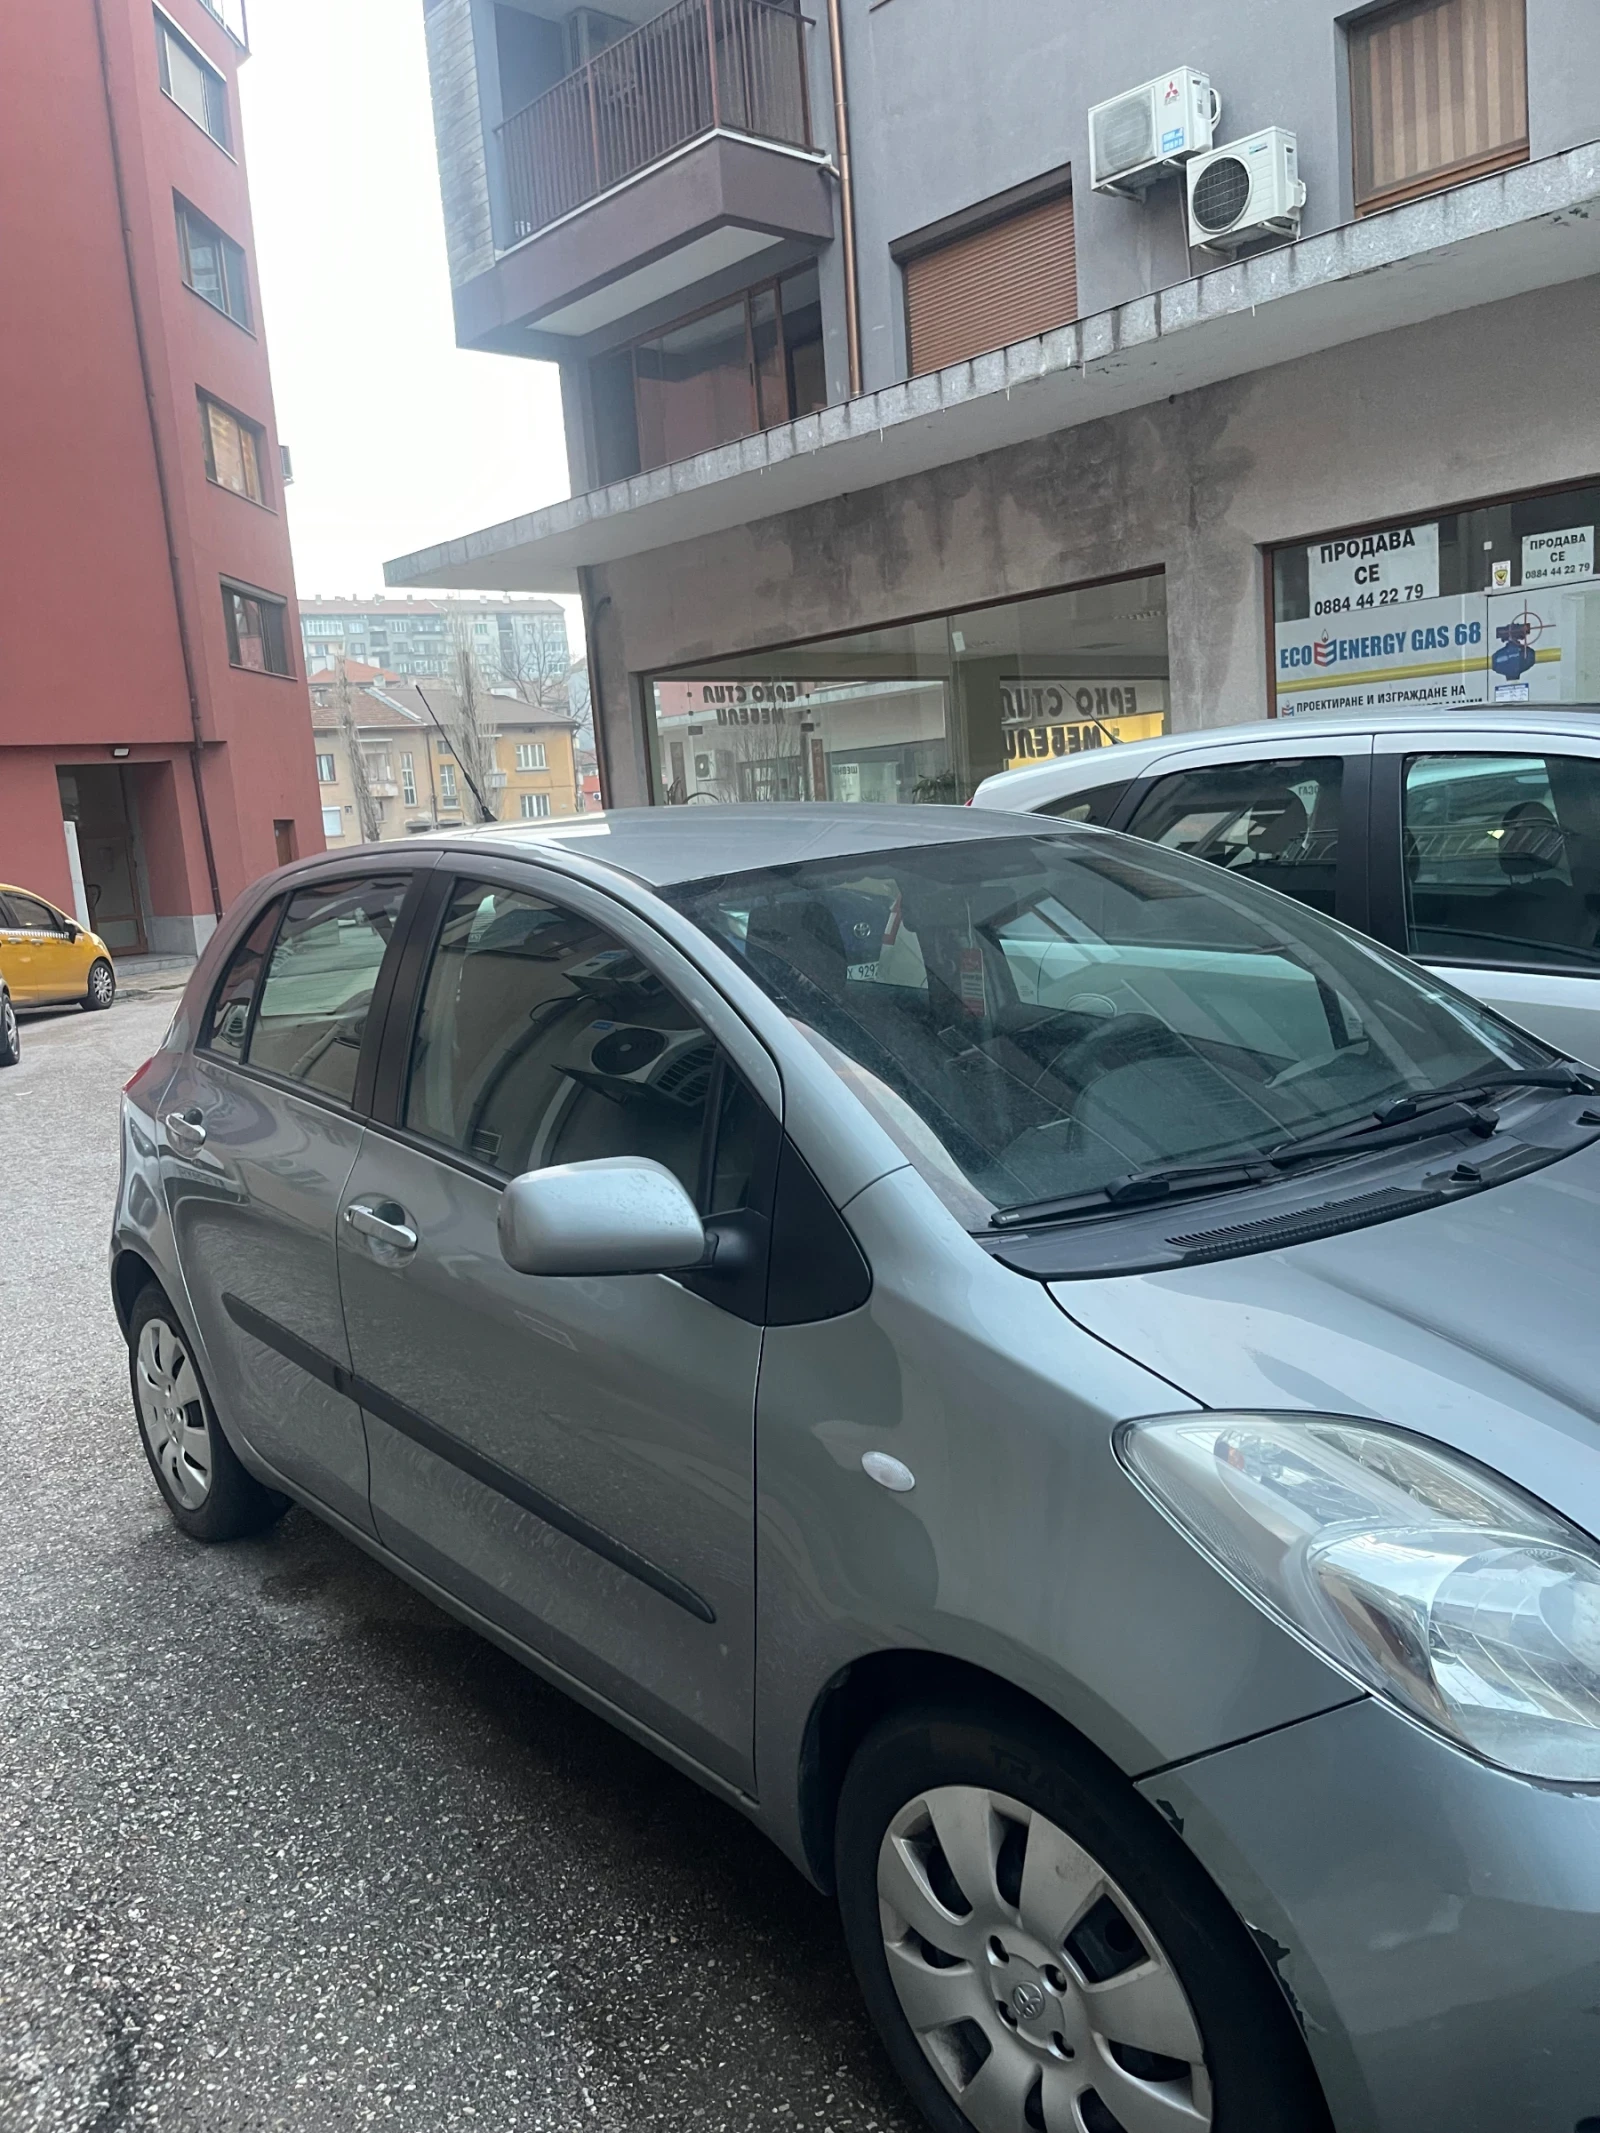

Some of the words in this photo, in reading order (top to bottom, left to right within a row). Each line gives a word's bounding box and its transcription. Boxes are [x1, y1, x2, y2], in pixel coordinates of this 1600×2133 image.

[1320, 529, 1416, 564] ПРОДАВА
[1529, 534, 1586, 551] ПРОДАВА
[1549, 551, 1565, 563] СЕ
[1354, 563, 1380, 585] СЕ
[1525, 568, 1548, 580] 0884
[1550, 567, 1562, 577] 44
[1564, 565, 1576, 575] 22
[1578, 563, 1590, 573] 79
[1314, 596, 1350, 616] 0884
[1356, 593, 1375, 611] 44
[1379, 588, 1399, 606] 22
[1404, 583, 1424, 601] 79
[1280, 645, 1313, 669] ECO
[1339, 632, 1406, 661] ENERGY
[1411, 627, 1450, 651] GAS
[1454, 621, 1482, 644] 68
[1296, 696, 1364, 713] ПРОЕКТИРАНЕ
[1367, 695, 1374, 705] И
[1377, 686, 1448, 704] ИЗГРАЖДАНЕ
[1451, 684, 1466, 696] НА
